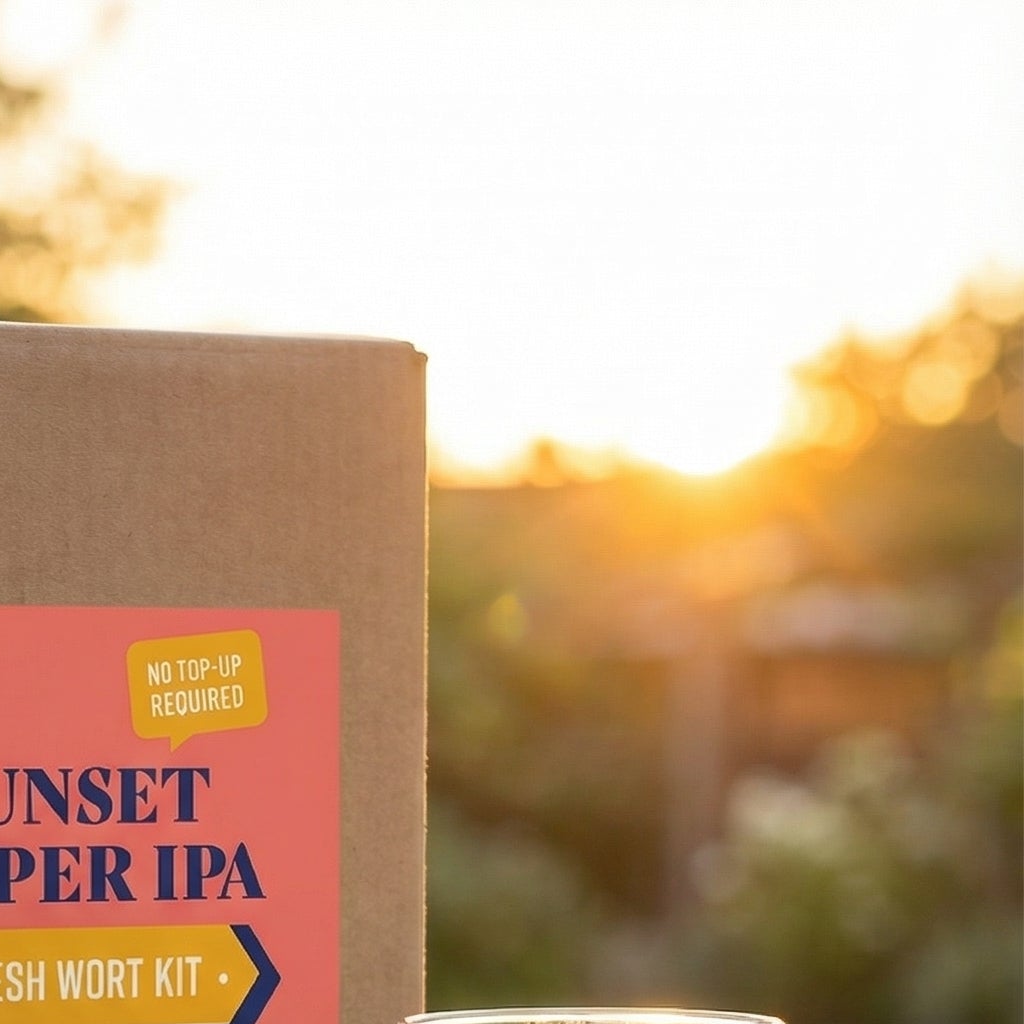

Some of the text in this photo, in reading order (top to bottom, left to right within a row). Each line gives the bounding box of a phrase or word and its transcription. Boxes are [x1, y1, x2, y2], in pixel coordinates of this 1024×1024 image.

[147, 654, 242, 686] NO TOP-UP
[151, 684, 244, 718] REQUIRED
[153, 841, 267, 900] IPA
[57, 958, 143, 1000] WORT
[155, 956, 202, 998] KIT
